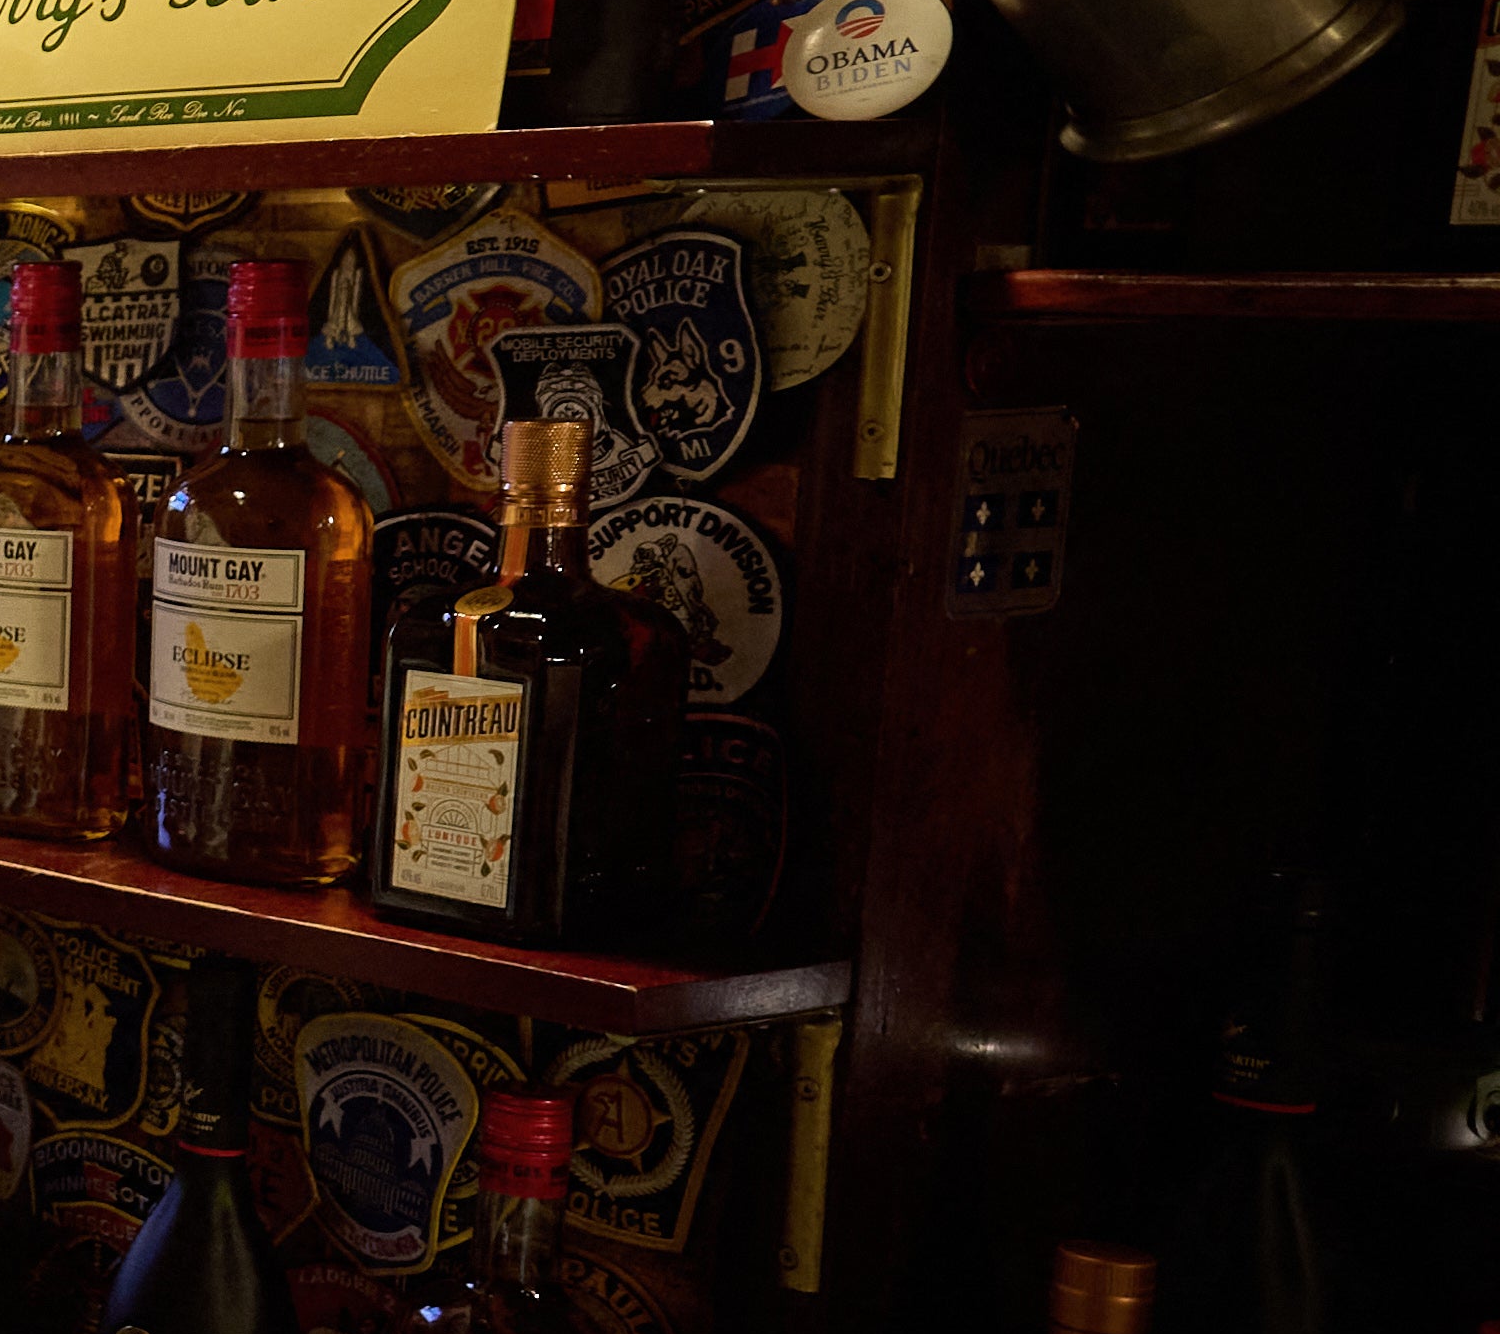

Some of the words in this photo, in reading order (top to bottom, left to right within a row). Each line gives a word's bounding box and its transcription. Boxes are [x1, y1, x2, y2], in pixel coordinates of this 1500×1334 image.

[805, 36, 920, 75] OBAMA
[816, 57, 912, 92] BIDEN
[607, 259, 668, 301] OYAL
[674, 249, 729, 286] OAK
[82, 302, 171, 323] LCATRAZ
[612, 280, 711, 320] POLICE
[501, 336, 552, 352] MOBILE
[553, 334, 626, 349] SECURITY
[512, 347, 617, 363] DEPLOYMENTS
[718, 337, 747, 373] 9
[681, 437, 713, 461] MI
[3, 536, 39, 563] GAY
[167, 550, 222, 583] MOUNT
[224, 558, 266, 584] GAY
[589, 505, 697, 561] SUPPORT
[697, 506, 779, 616] DIVISION
[4, 561, 35, 579] 1703
[225, 581, 261, 602] 1703
[171, 644, 252, 672] ECLIPSE
[404, 701, 519, 741] COINTREAU
[51, 931, 119, 968] POLICE
[305, 1035, 418, 1077] METROPOLITAN
[410, 1060, 465, 1127] POLICE
[33, 1139, 171, 1187] BLOOMINGTON
[565, 1187, 663, 1236] OLICE
